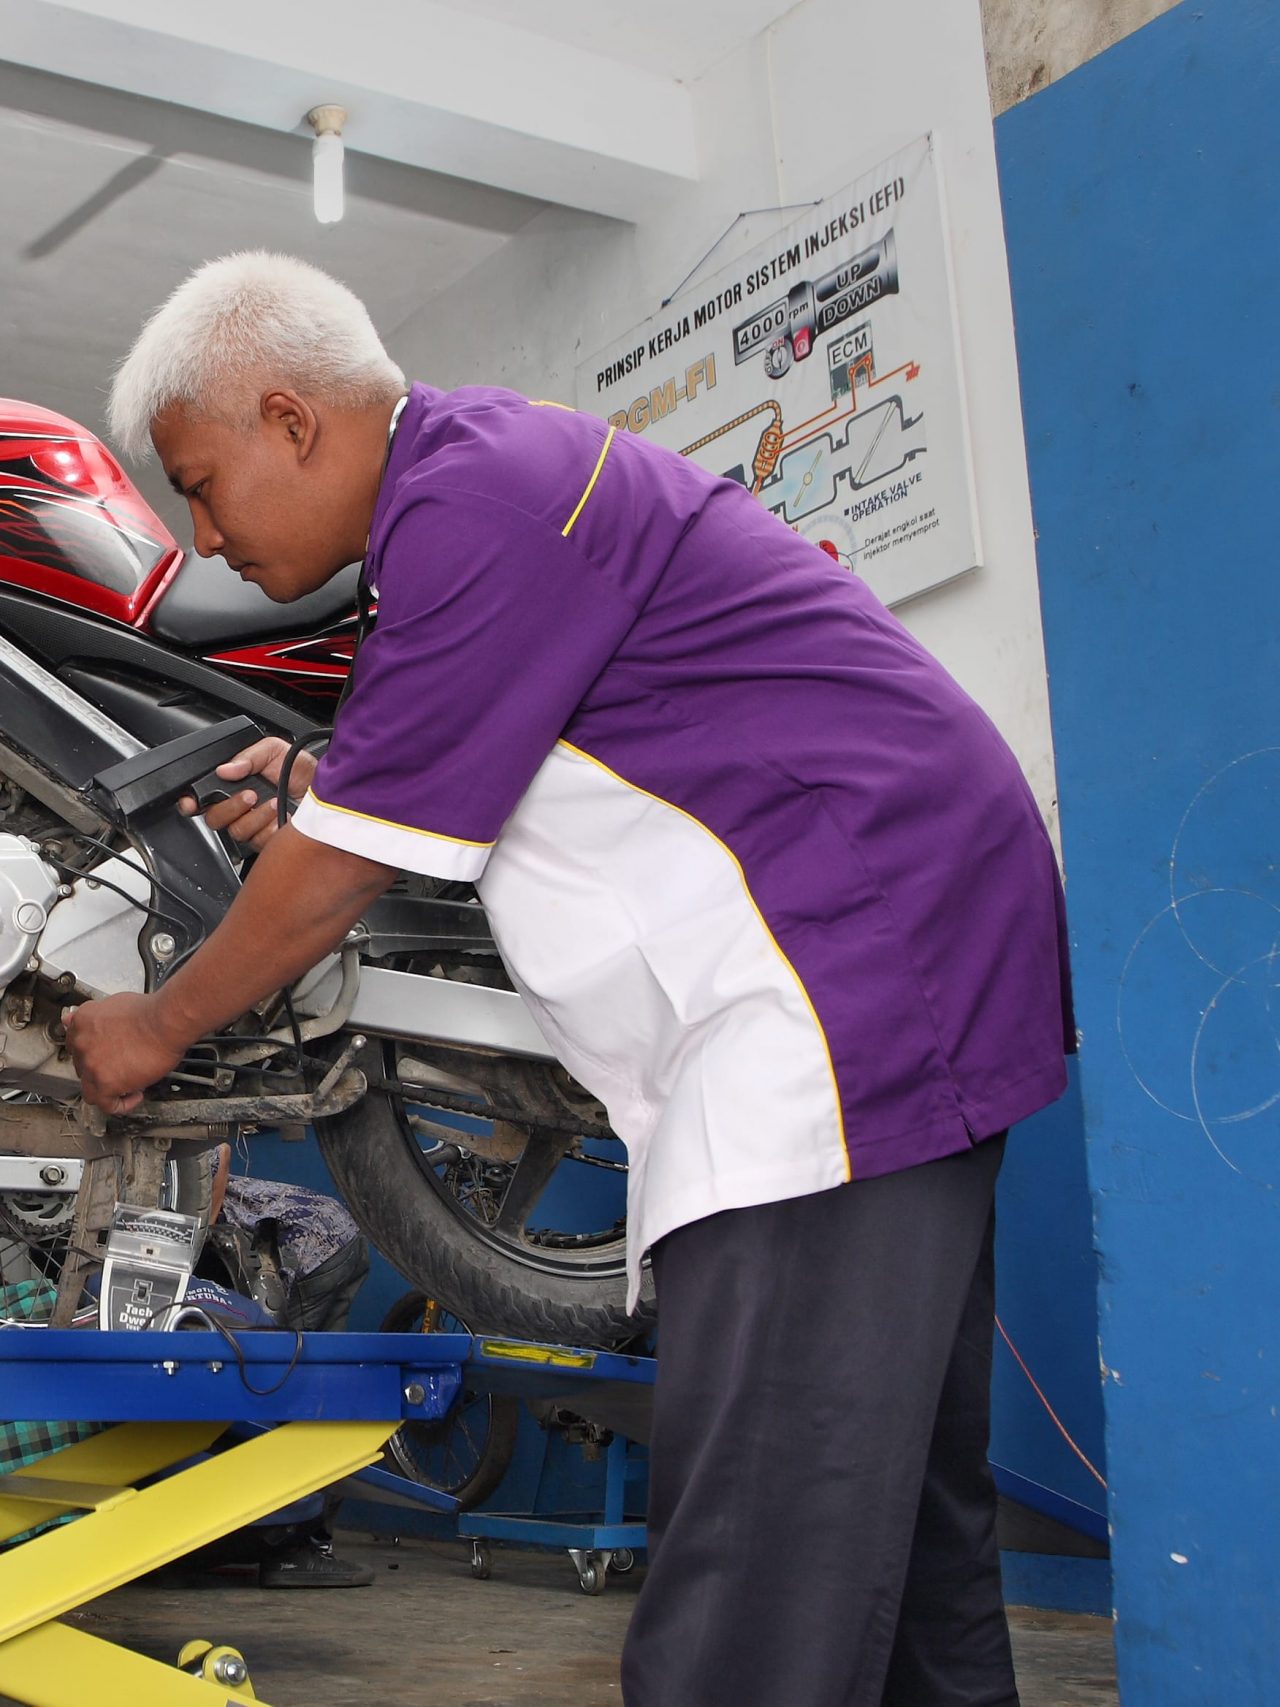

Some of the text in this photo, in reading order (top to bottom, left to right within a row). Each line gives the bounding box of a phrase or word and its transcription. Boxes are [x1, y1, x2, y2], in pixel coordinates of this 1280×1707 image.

[597, 177, 905, 393] PRINSIP KERJA MOTOR SISTEM INJEKSI (EFI)
[837, 262, 862, 290] UP
[823, 276, 881, 326] DOWN
[740, 302, 809, 347] 4000 rpm
[772, 336, 785, 348] ON
[832, 332, 868, 365] ECM
[851, 472, 923, 515] INTAKE VALVE
[852, 488, 908, 522] OPERATION
[865, 529, 890, 548] Derajat
[892, 516, 918, 532] engkol
[120, 1312, 155, 1328] Dwel
[125, 1303, 153, 1318] Tach
